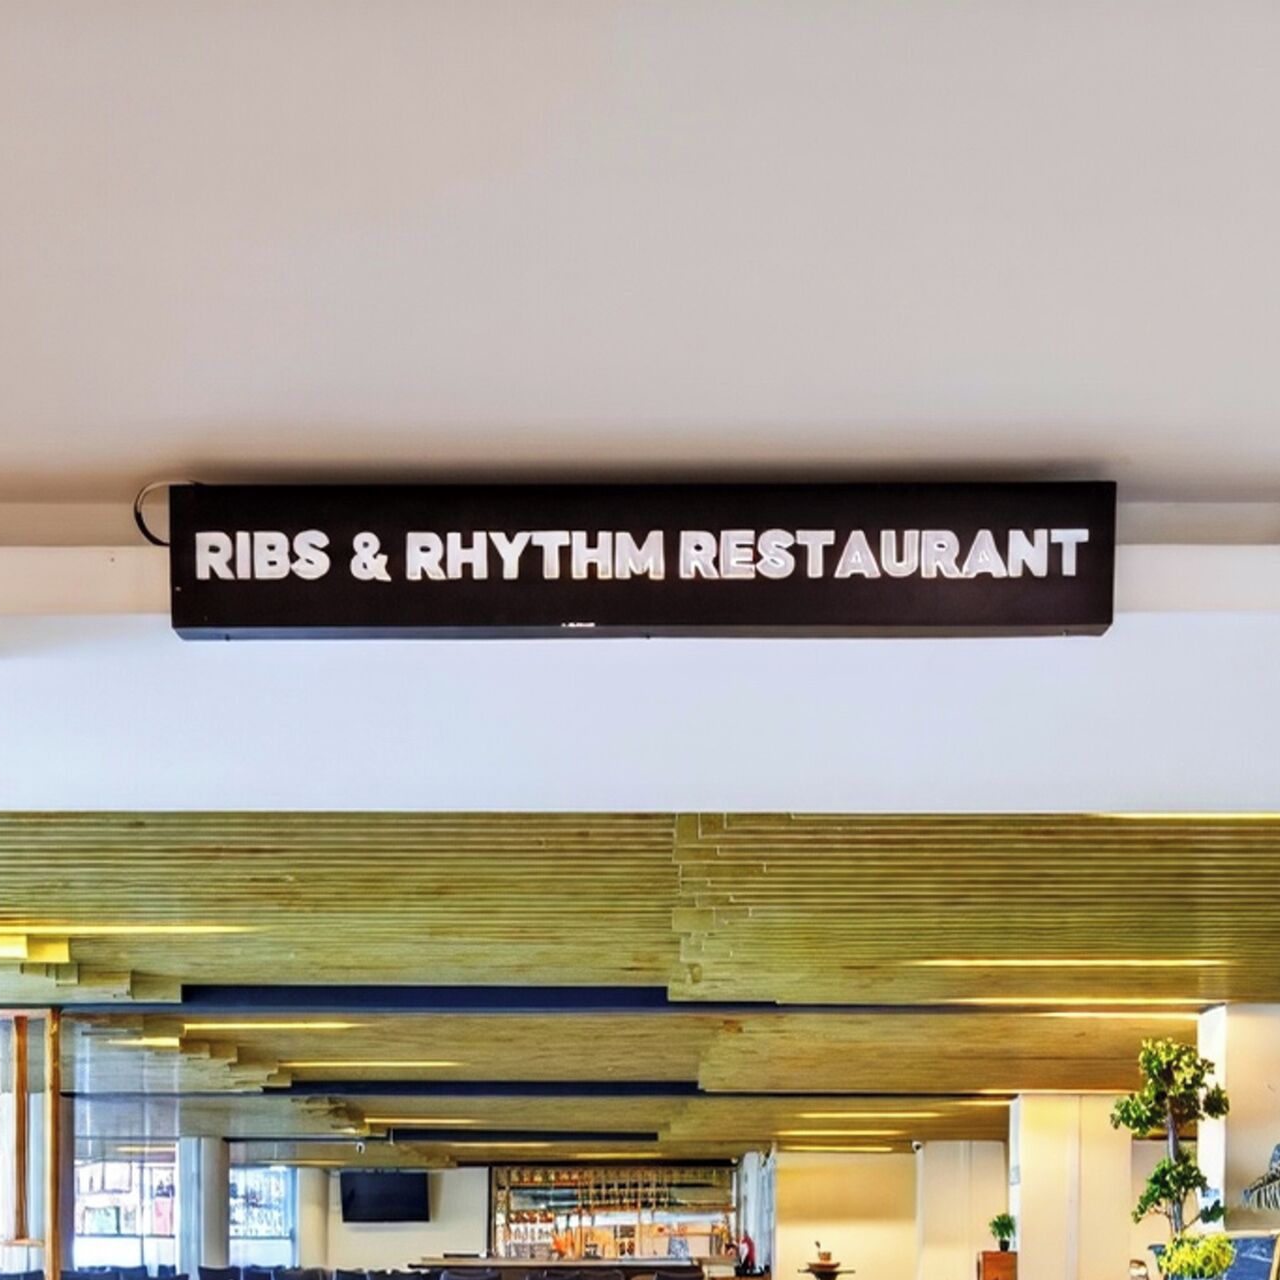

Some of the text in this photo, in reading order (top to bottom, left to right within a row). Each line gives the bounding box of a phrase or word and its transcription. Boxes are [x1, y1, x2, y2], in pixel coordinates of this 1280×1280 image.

[195, 529, 1089, 582] RIBS & RHYTHM RESTAURANT
